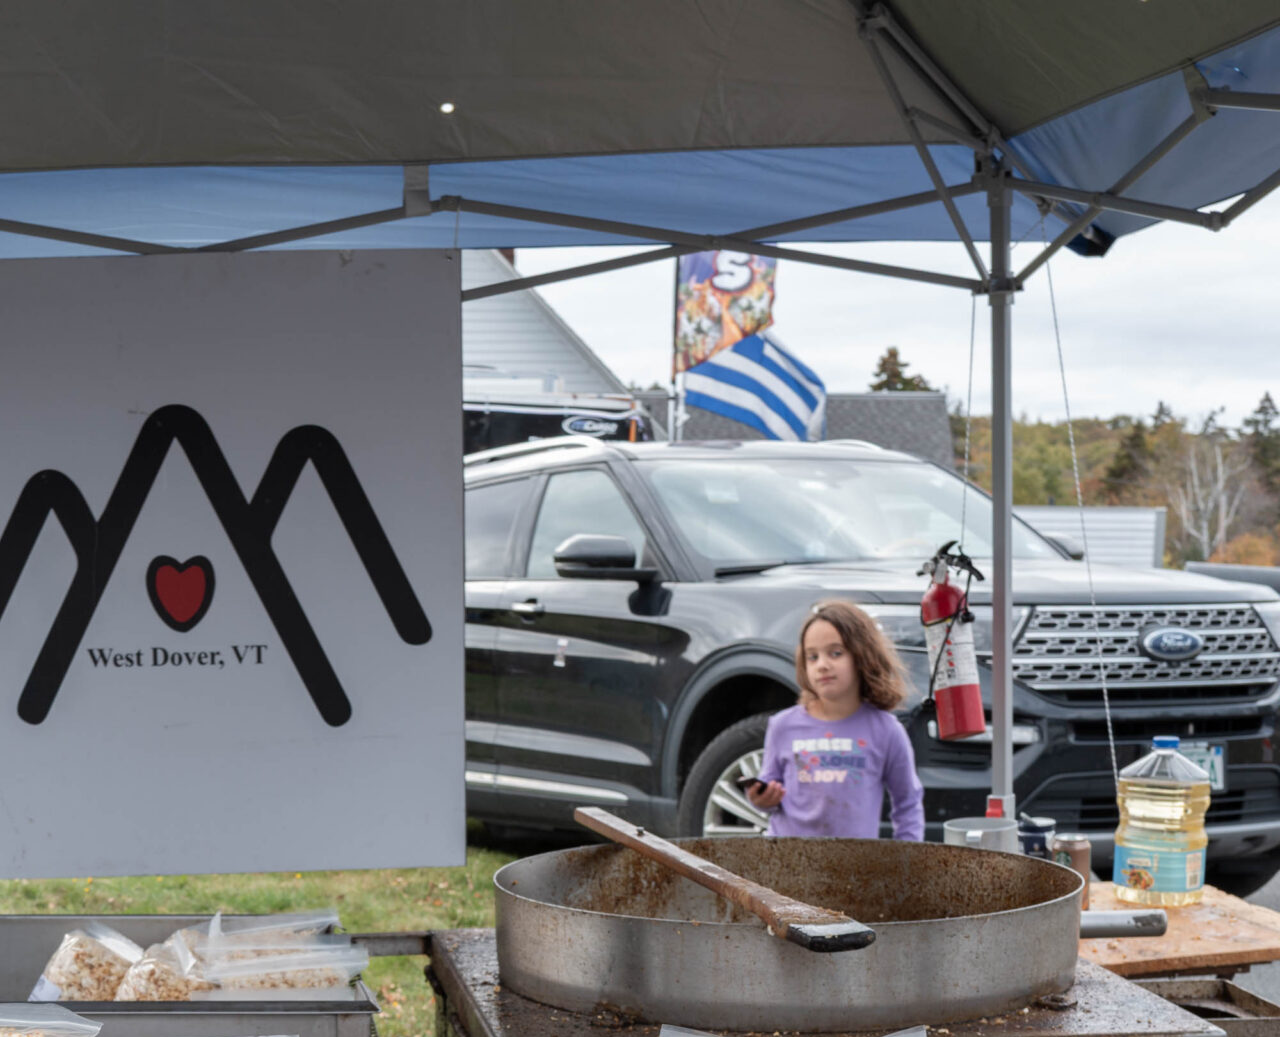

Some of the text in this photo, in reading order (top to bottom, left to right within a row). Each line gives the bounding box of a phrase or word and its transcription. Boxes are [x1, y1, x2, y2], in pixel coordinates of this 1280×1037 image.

[87, 644, 268, 669] West Dover, VT
